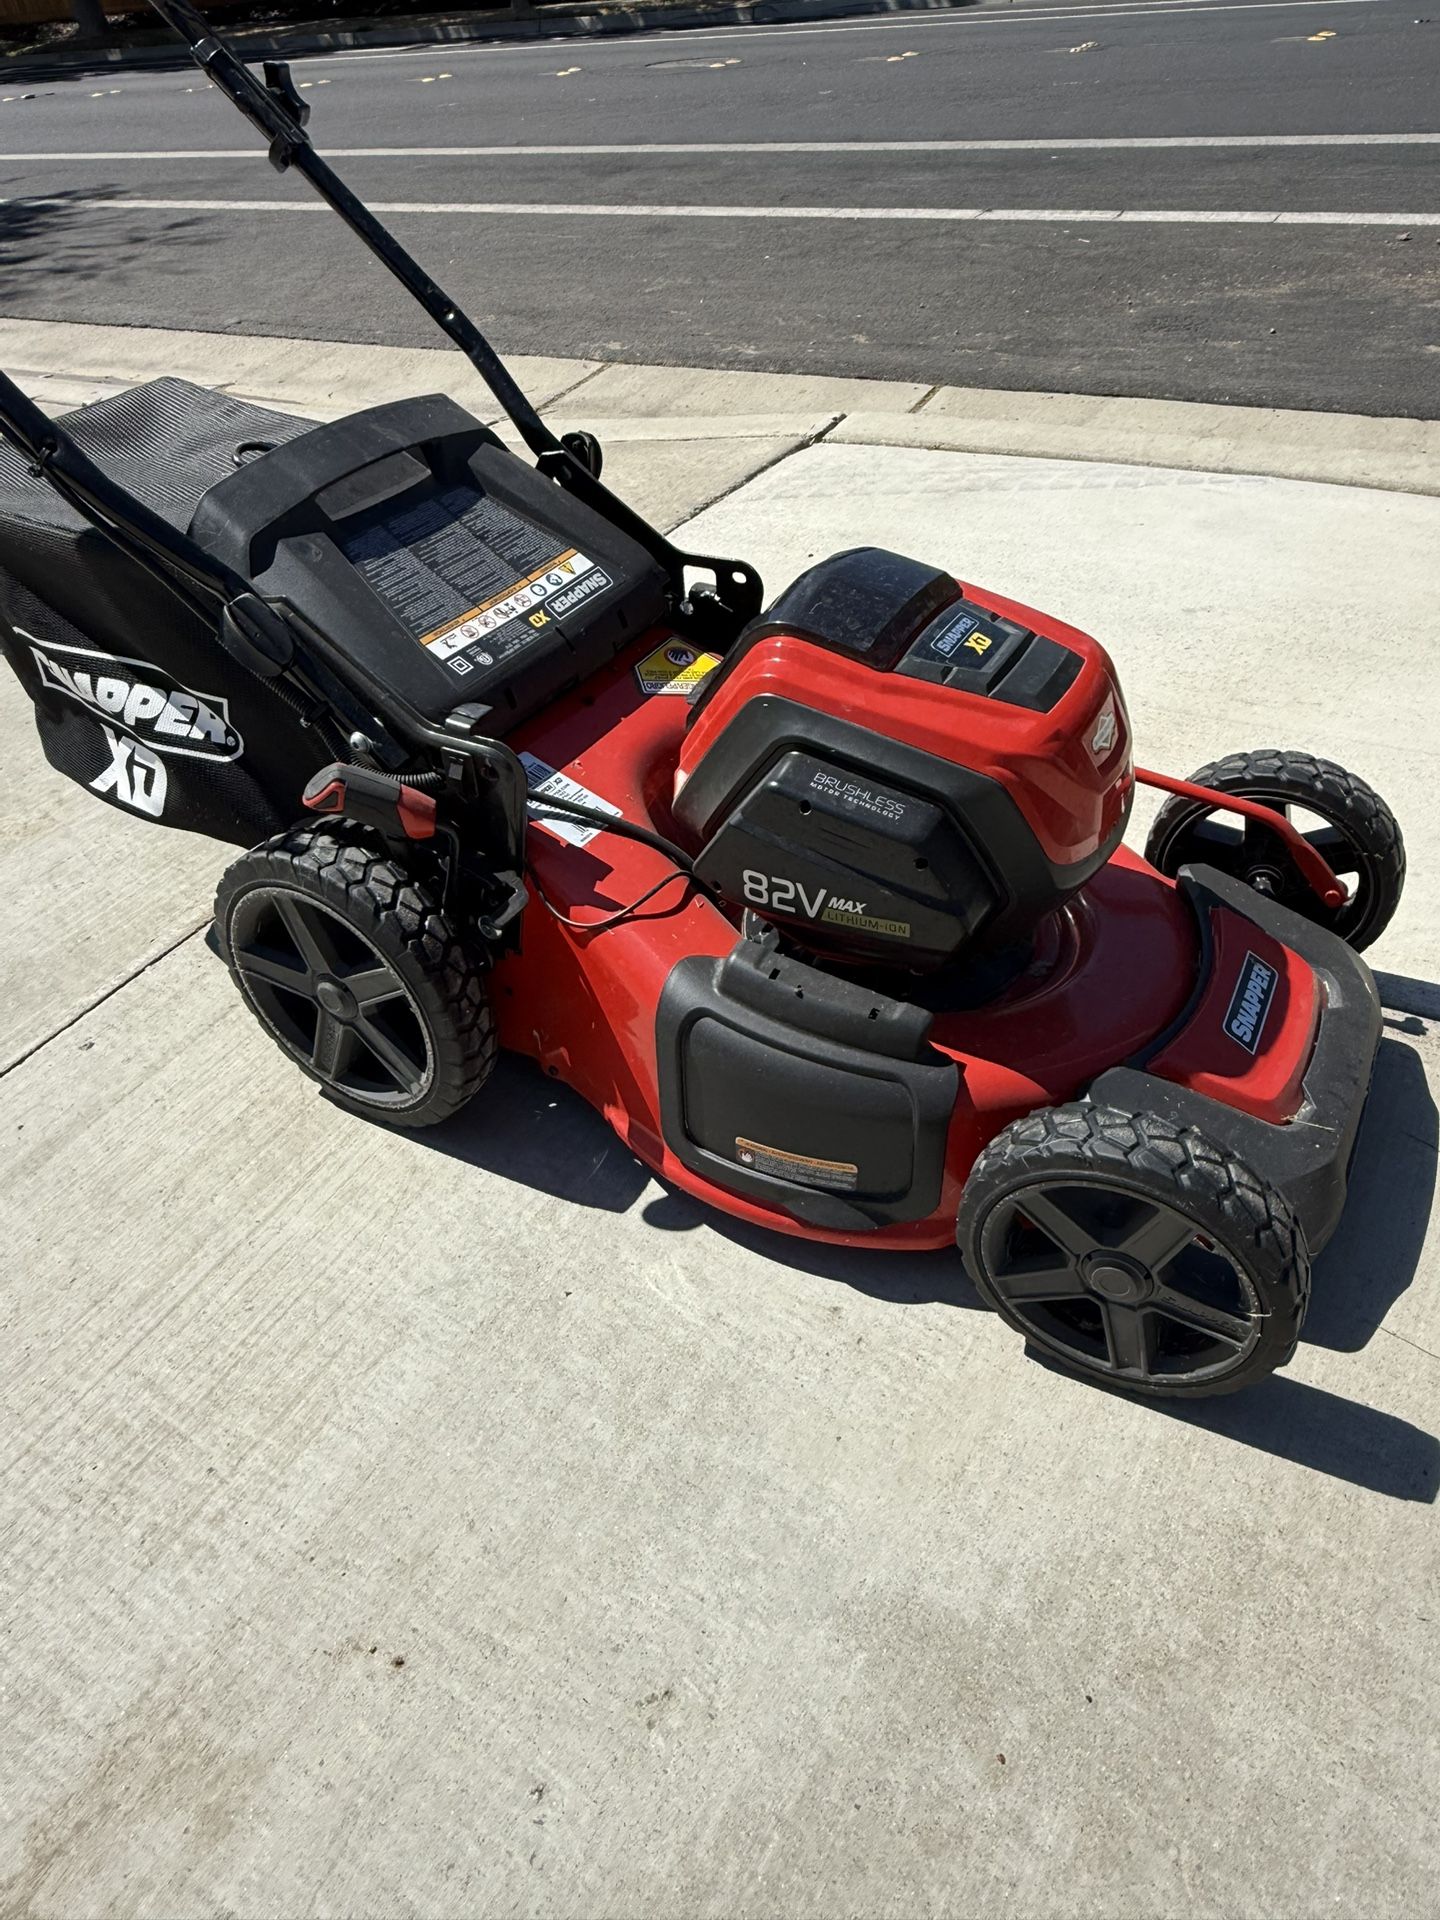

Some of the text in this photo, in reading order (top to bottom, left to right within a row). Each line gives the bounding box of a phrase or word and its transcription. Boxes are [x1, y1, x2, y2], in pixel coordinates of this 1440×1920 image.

[550, 572, 607, 613] SNAPPER
[528, 609, 551, 628] XD
[936, 617, 972, 653] SNAPPER
[963, 631, 992, 656] XD
[48, 659, 228, 745] PPER
[89, 723, 168, 817] XD
[810, 782, 901, 821] MOTOR TECHNOLOGY
[813, 772, 906, 815] BRUSHLESS
[742, 869, 868, 919] 82V MAX
[1231, 962, 1272, 1043] SNAPPER
